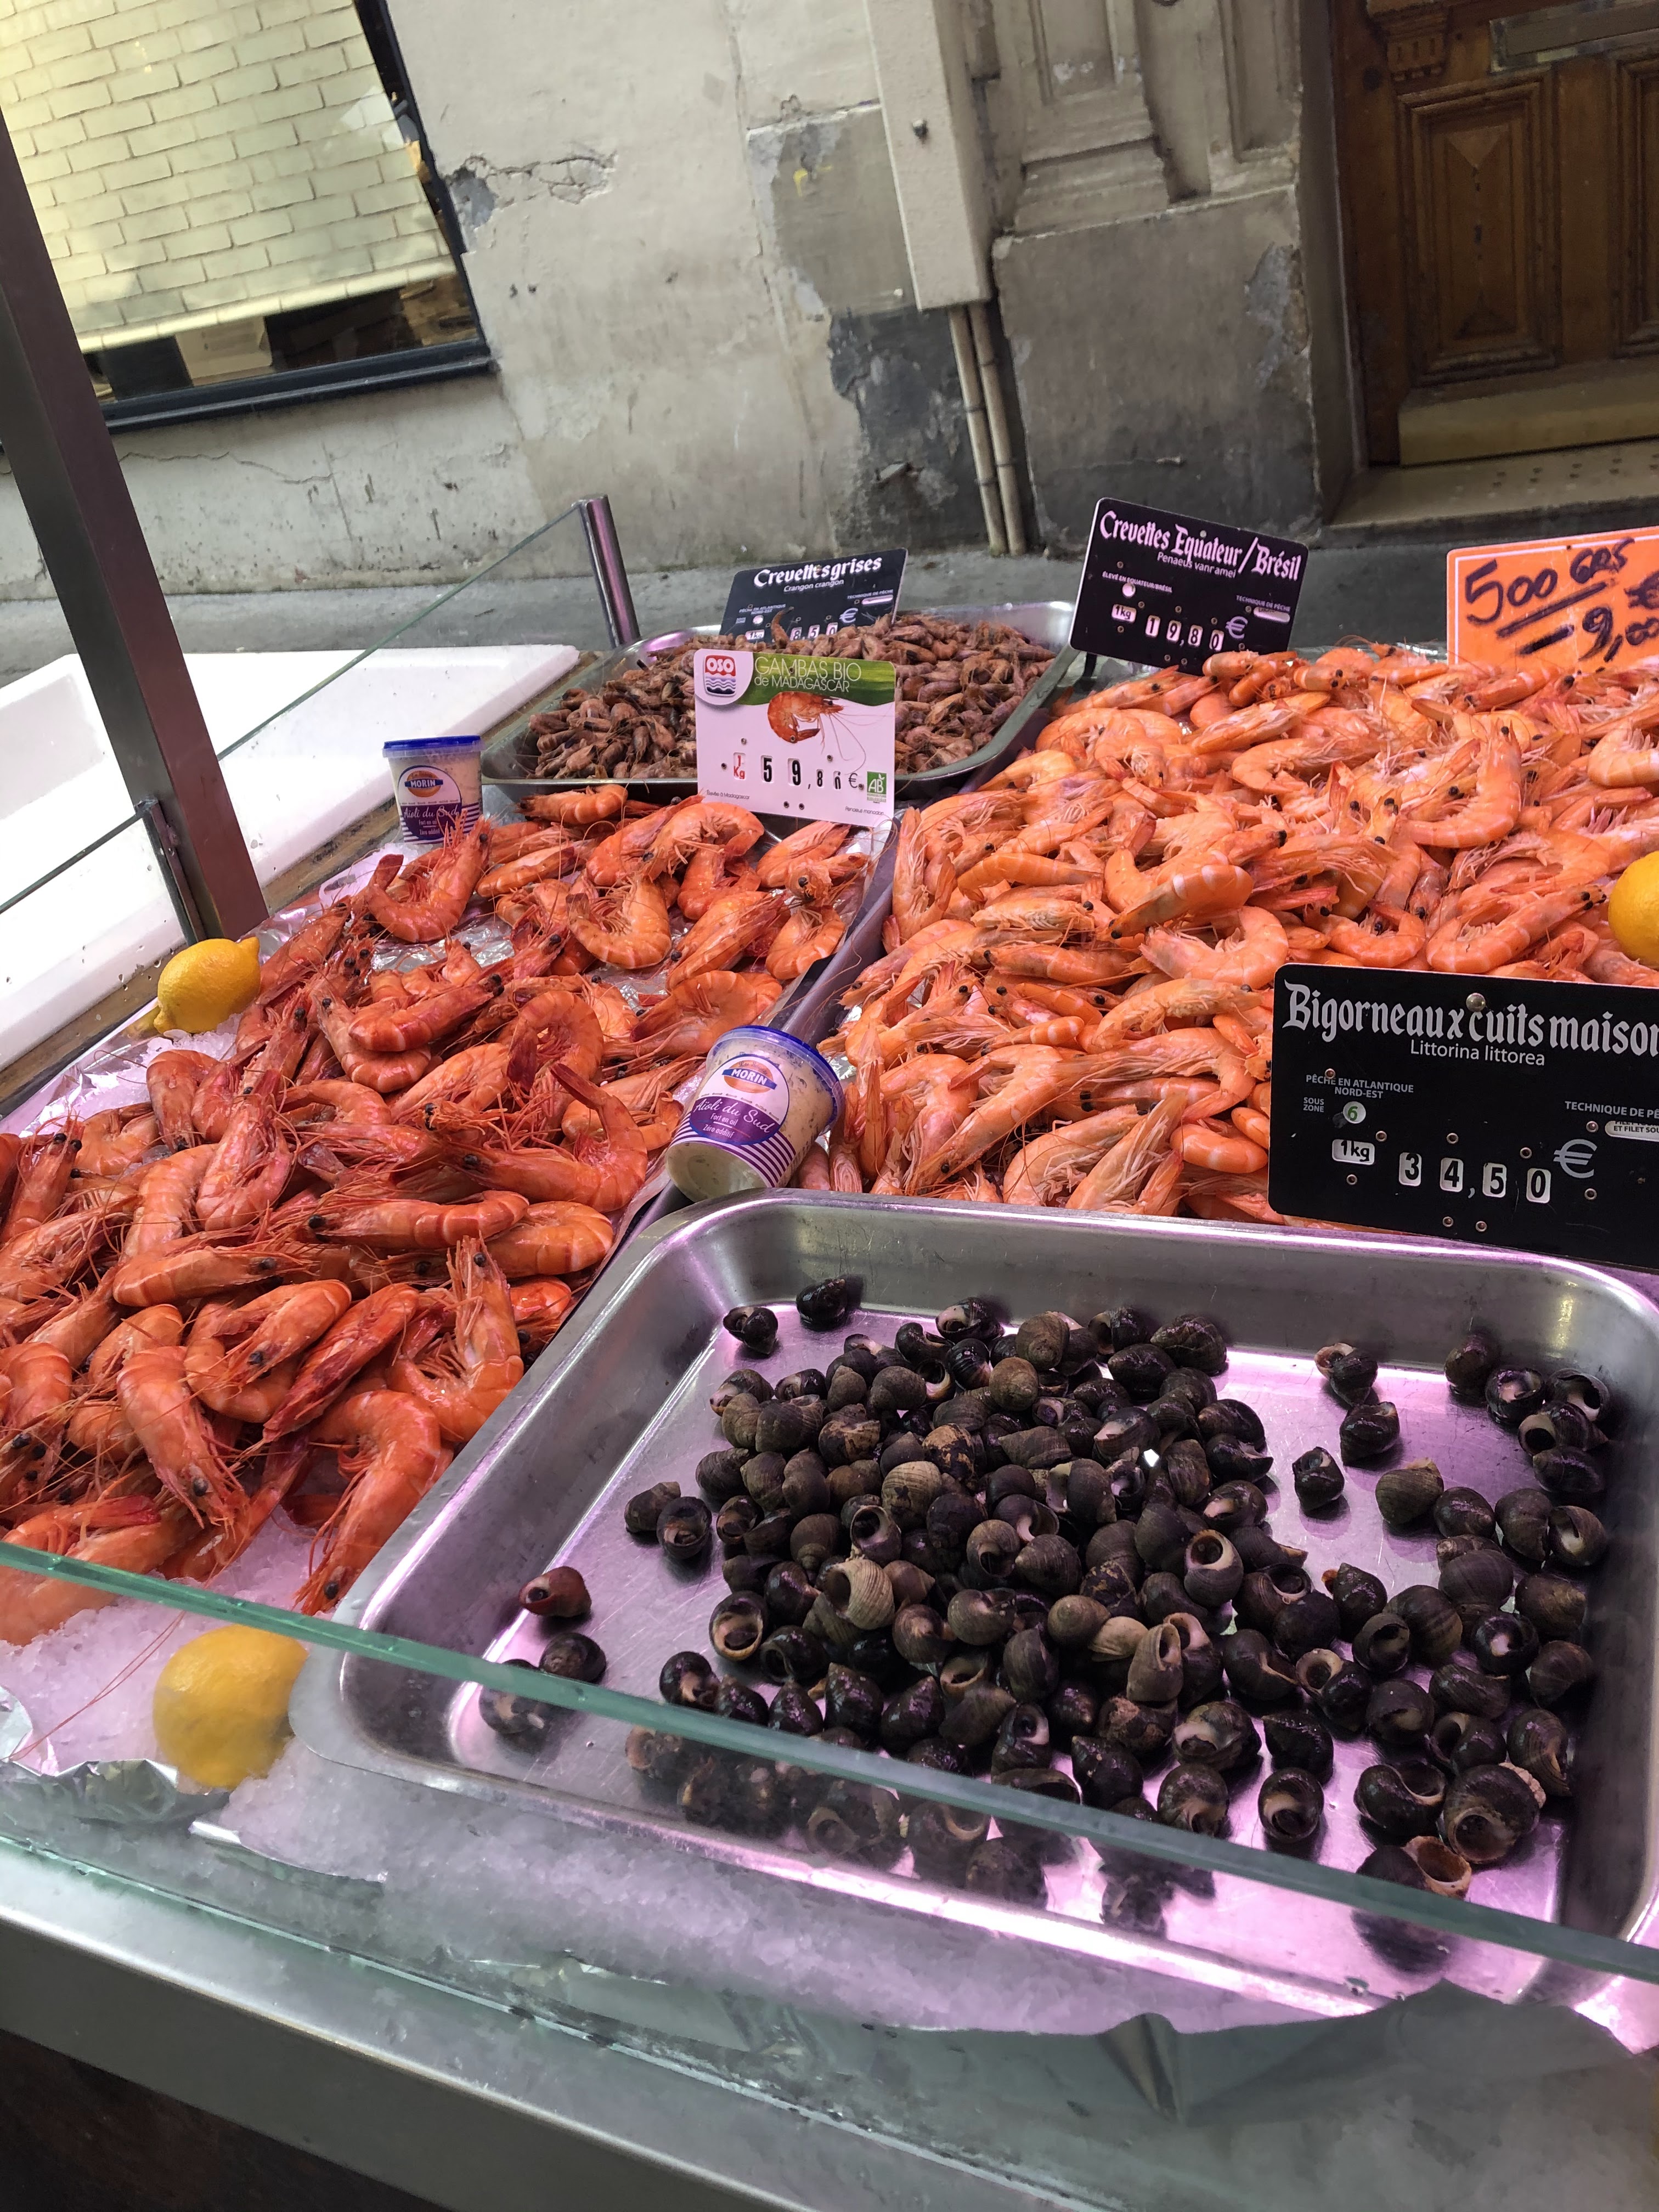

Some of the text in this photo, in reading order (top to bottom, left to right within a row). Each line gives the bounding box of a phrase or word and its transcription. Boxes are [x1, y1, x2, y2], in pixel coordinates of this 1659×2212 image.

[1099, 510, 1171, 550] Crevettes
[1157, 551, 1193, 569] Penaeus
[1465, 558, 1558, 625] 500
[1116, 605, 1131, 620] 1kg
[706, 658, 734, 673] OSO
[755, 657, 862, 681] GAMBAS BIO
[754, 674, 850, 692] de MADAGASCAR
[410, 779, 436, 787] MORIN
[868, 778, 884, 793] AB
[1282, 979, 1464, 1042] Bigorneaux
[1469, 1003, 1544, 1047] cuits
[1411, 1040, 1545, 1066] Littorina littorea
[731, 1069, 768, 1085] MORIN
[1338, 1077, 1351, 1086] EN
[1352, 1079, 1414, 1093] ATLANTIQUE
[1334, 1086, 1383, 1099] NORD-EST
[1303, 1097, 1324, 1105] SOUS
[1303, 1104, 1324, 1113] ZONE
[722, 1102, 741, 1116] du
[743, 1110, 775, 1133] Sud
[1347, 1105, 1358, 1121] 6
[1565, 1101, 1627, 1115] TECHNIQUE
[1629, 1108, 1644, 1118] DE
[703, 1124, 715, 1132] Zéro
[1341, 1139, 1369, 1162] 1kg
